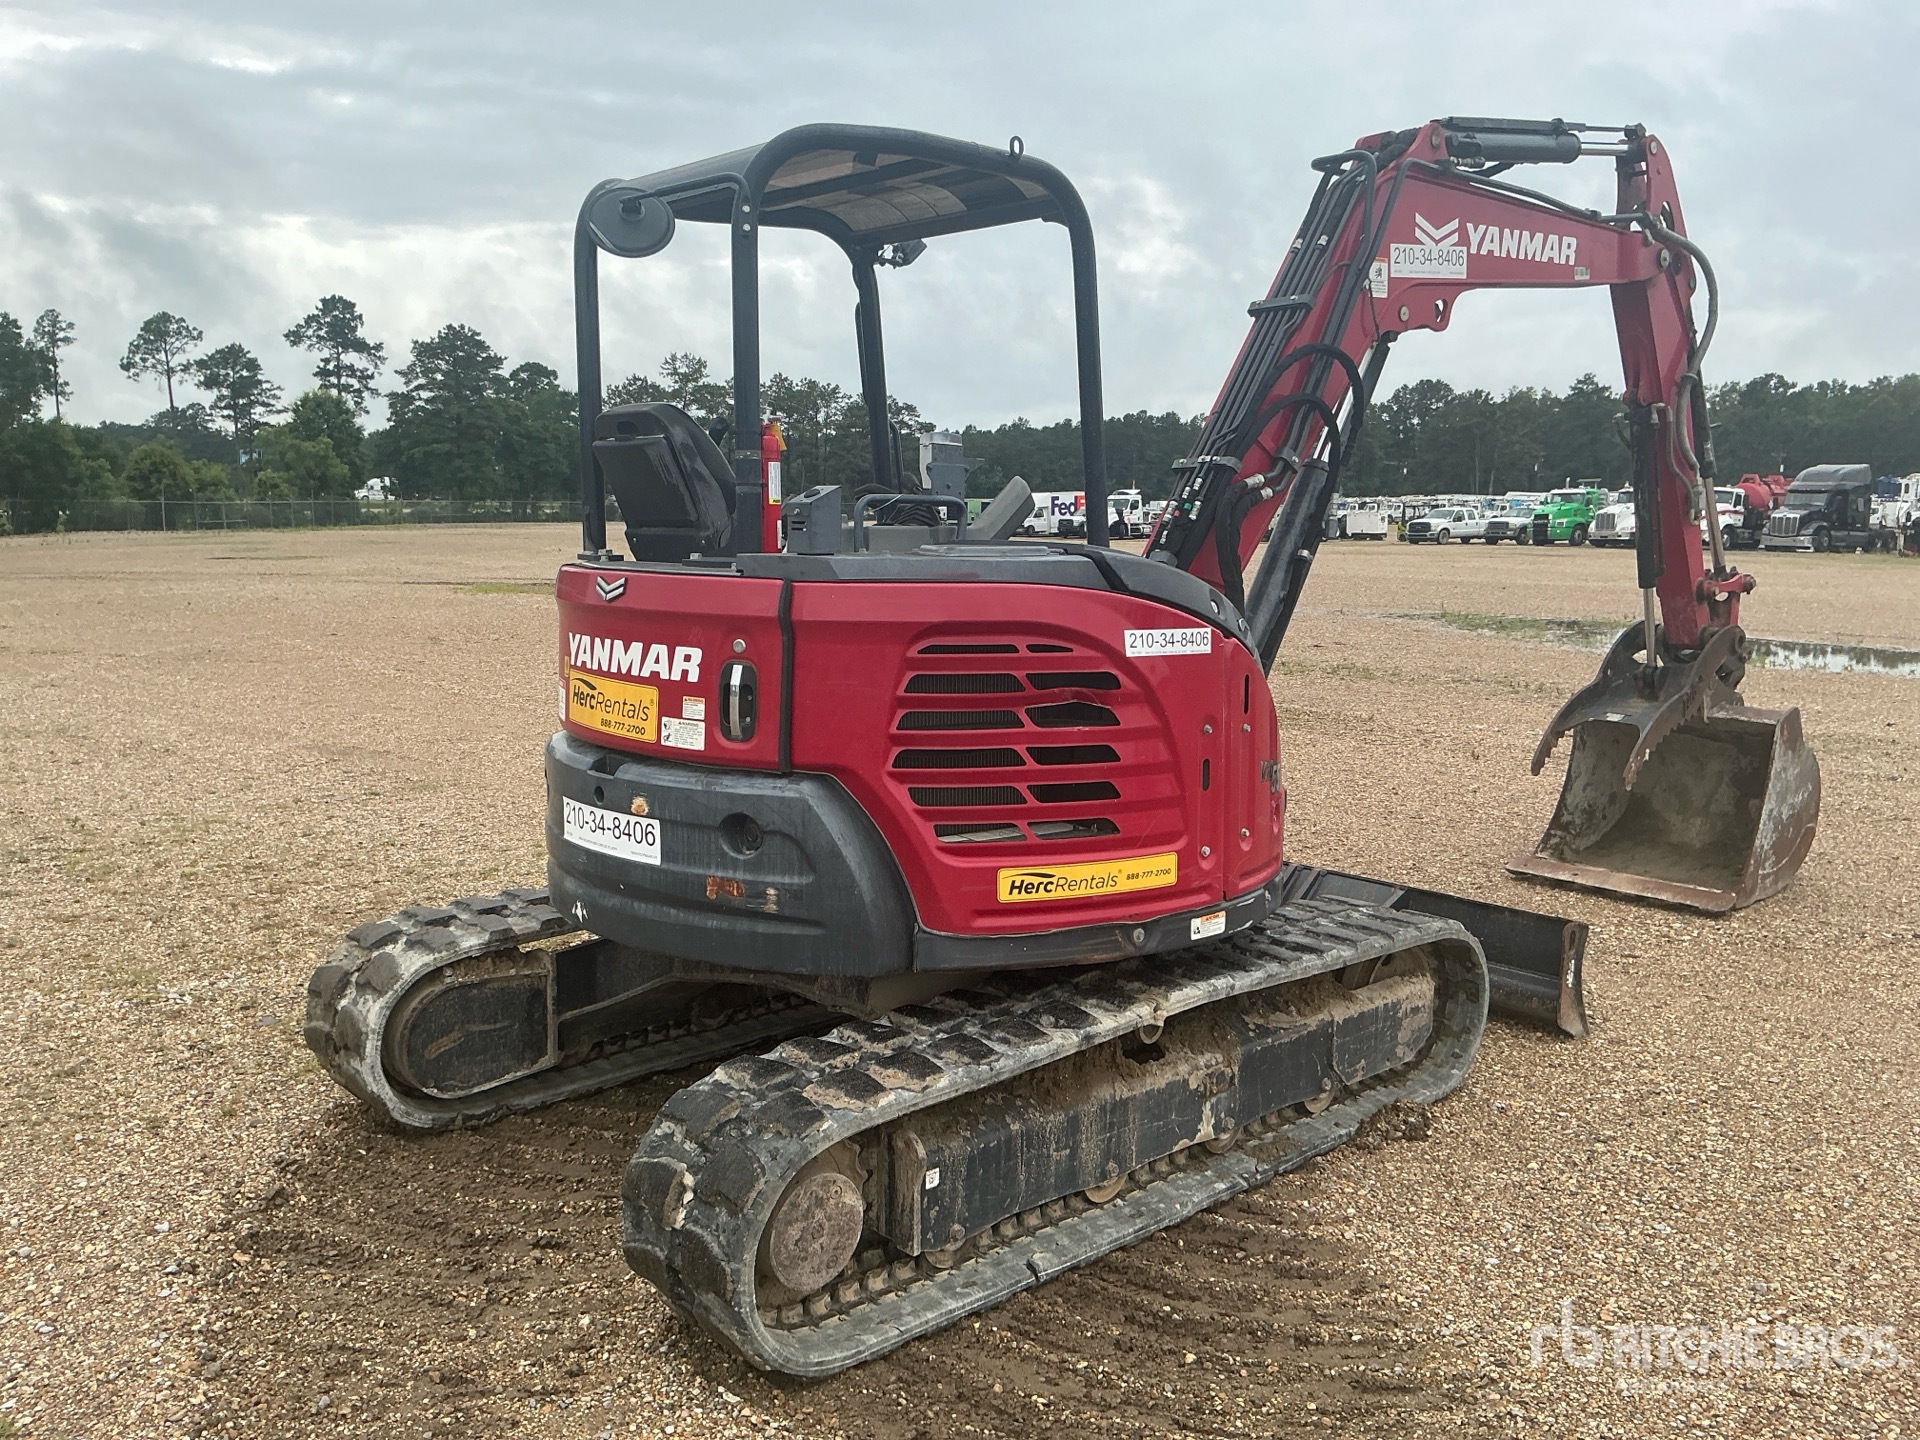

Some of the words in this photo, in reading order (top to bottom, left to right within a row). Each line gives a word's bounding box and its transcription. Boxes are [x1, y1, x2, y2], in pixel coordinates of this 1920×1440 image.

[1466, 222, 1577, 265] YANMAR
[1393, 246, 1465, 268] 210-34-8406
[1129, 631, 1210, 649] 210-34-8406
[568, 632, 703, 683] YANMAR
[600, 717, 646, 736] 888-777-2700
[565, 801, 656, 847] 210-34-8406
[1126, 868, 1171, 881] 888-777-2700
